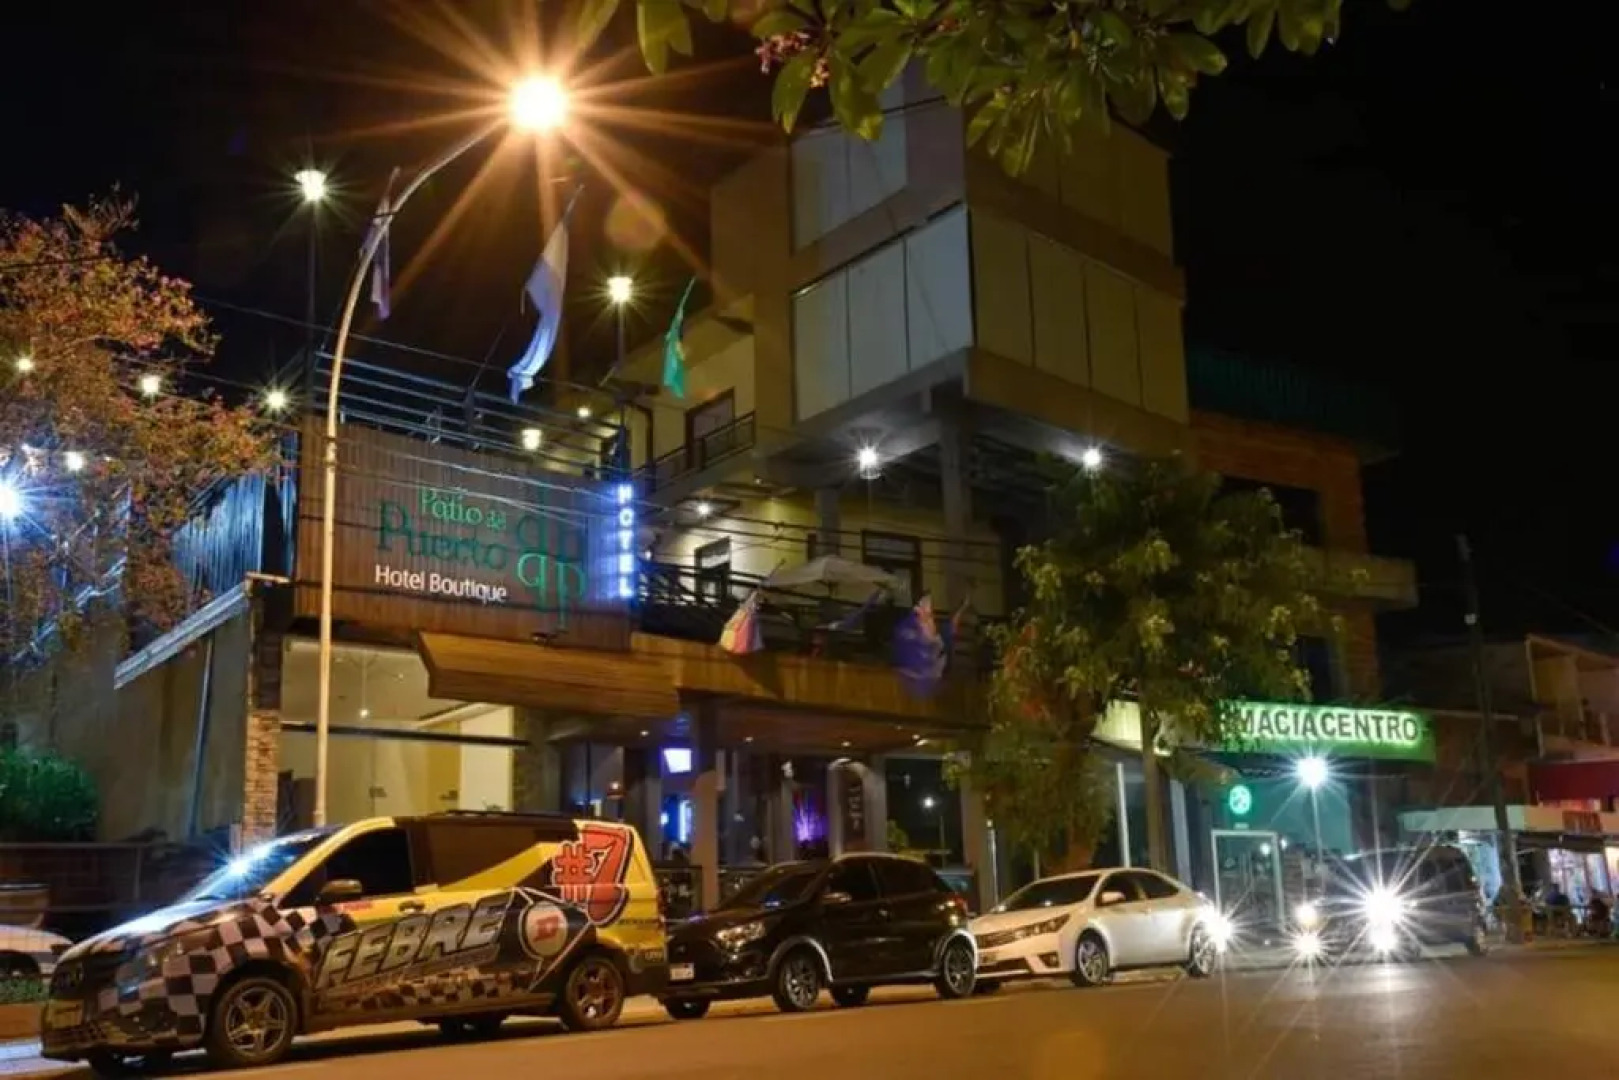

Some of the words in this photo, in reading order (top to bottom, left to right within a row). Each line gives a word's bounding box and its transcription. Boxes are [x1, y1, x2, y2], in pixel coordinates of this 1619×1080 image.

[377, 500, 508, 570] Puerto
[422, 487, 482, 525] Patio
[617, 483, 634, 598] HOTEL
[375, 562, 425, 592] Hotel
[429, 573, 507, 605] Boutique
[314, 894, 506, 985] FEBRE
